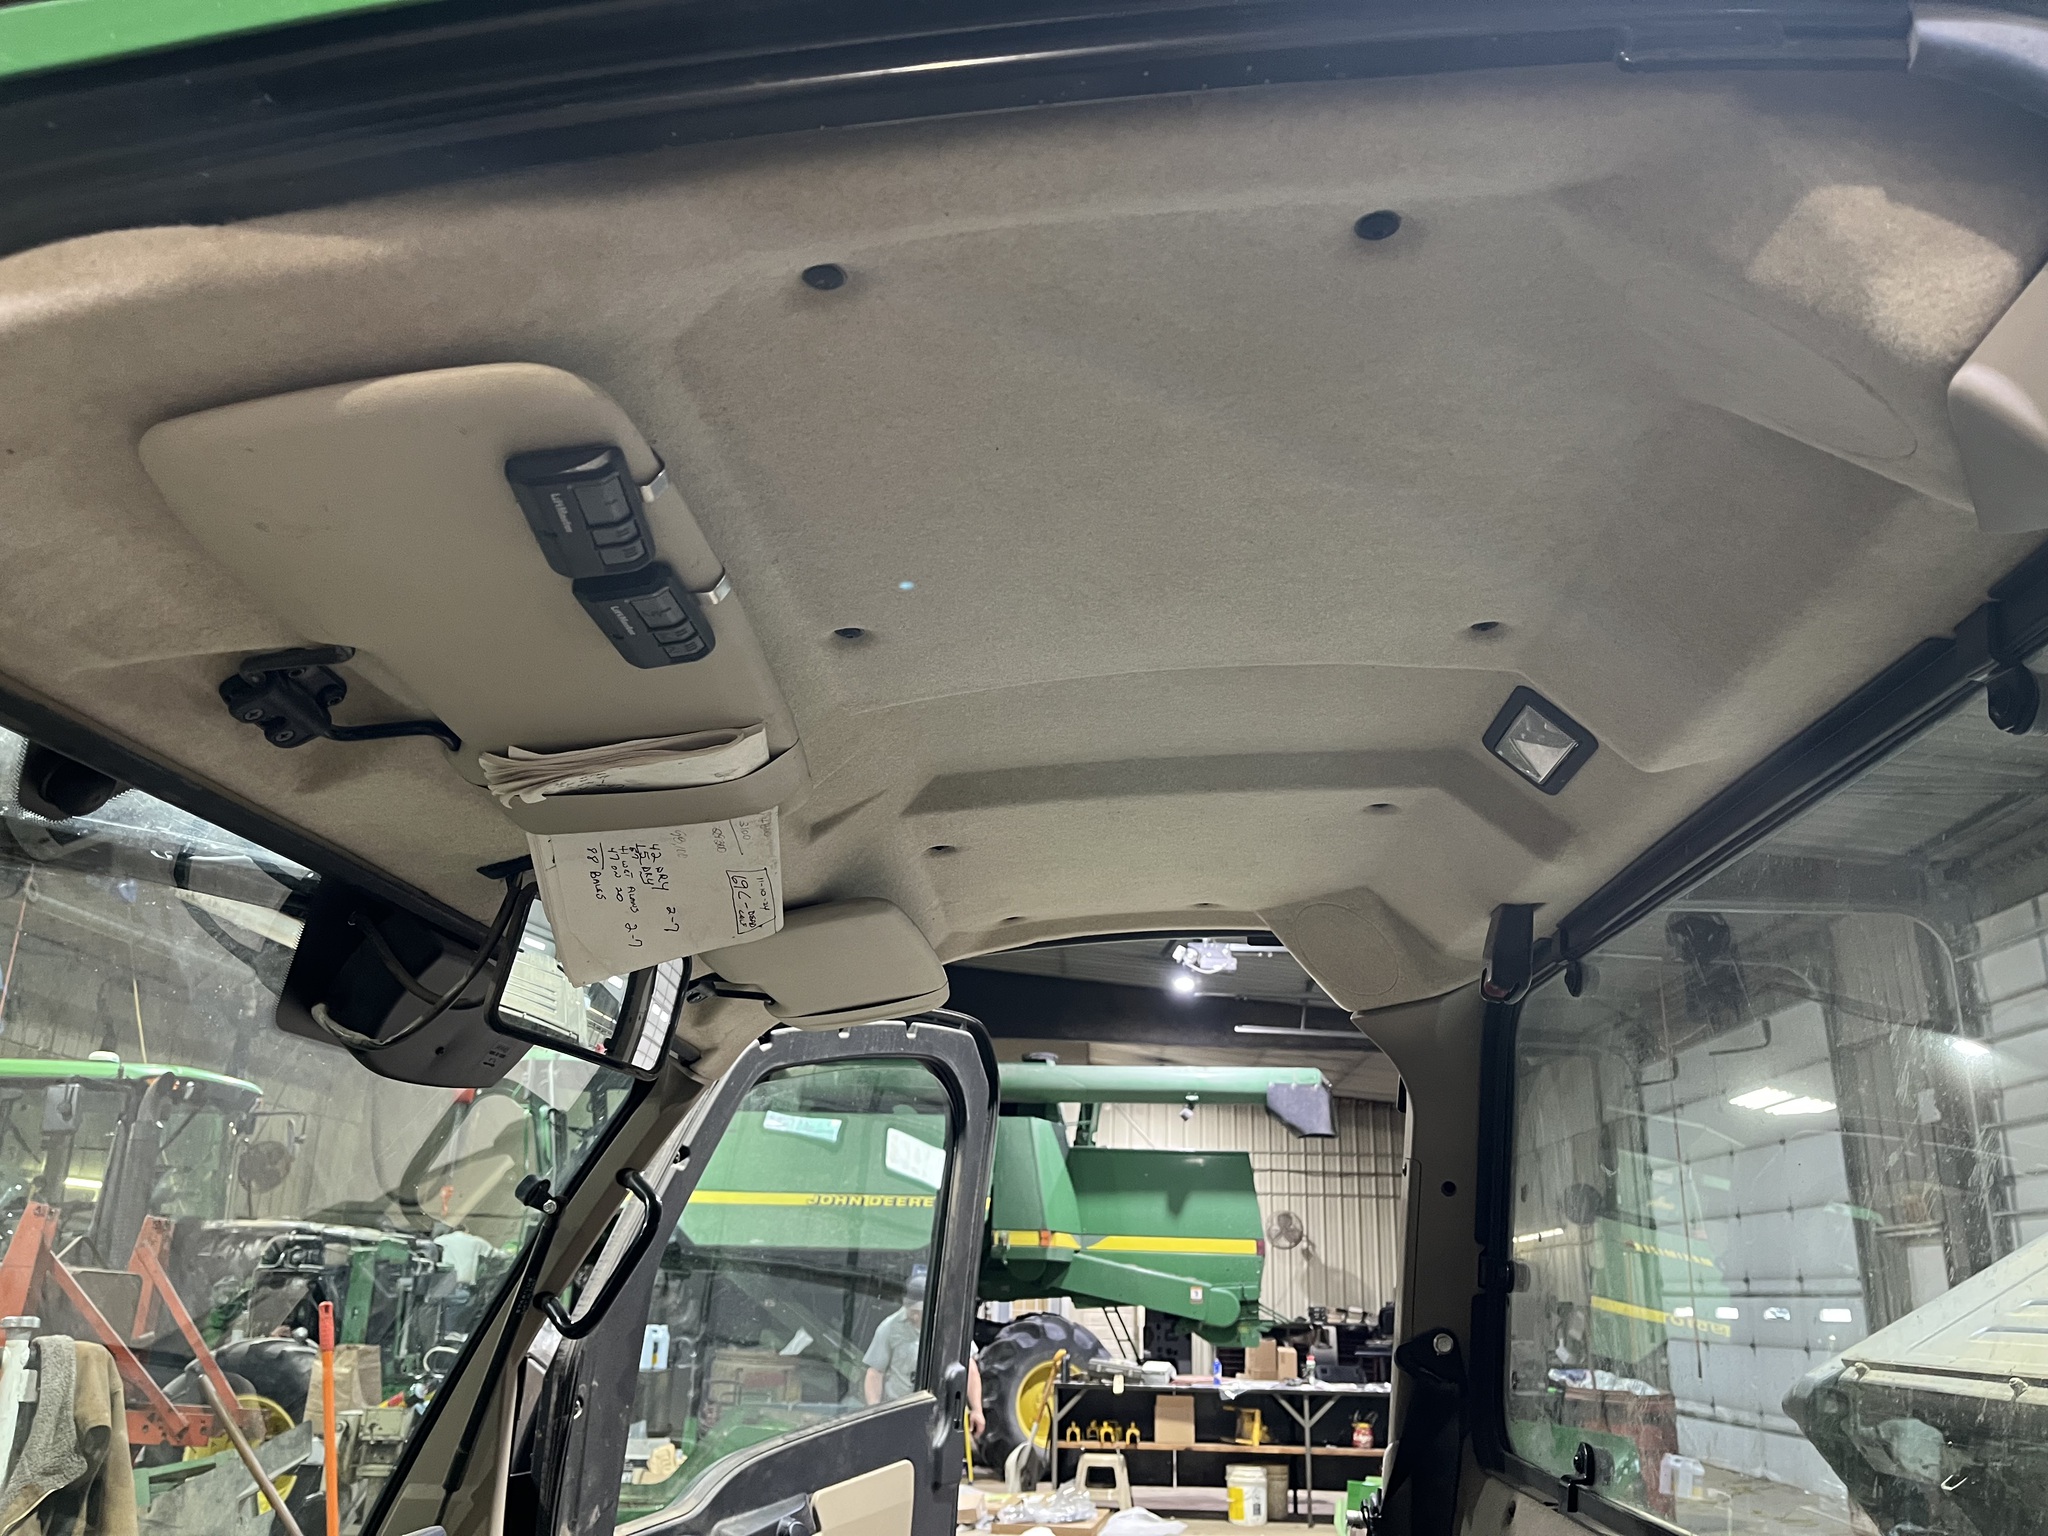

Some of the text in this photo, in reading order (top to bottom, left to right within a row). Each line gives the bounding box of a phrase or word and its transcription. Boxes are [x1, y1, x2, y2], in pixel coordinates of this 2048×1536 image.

[549, 492, 573, 533] LiftMaster
[610, 605, 636, 636] LiftMaster
[587, 847, 599, 864] 88
[608, 847, 620, 861] 47
[649, 844, 662, 863] 42
[641, 866, 654, 885] DRY
[651, 866, 670, 890] DRY
[808, 1195, 934, 1207] JOHN DEERE
